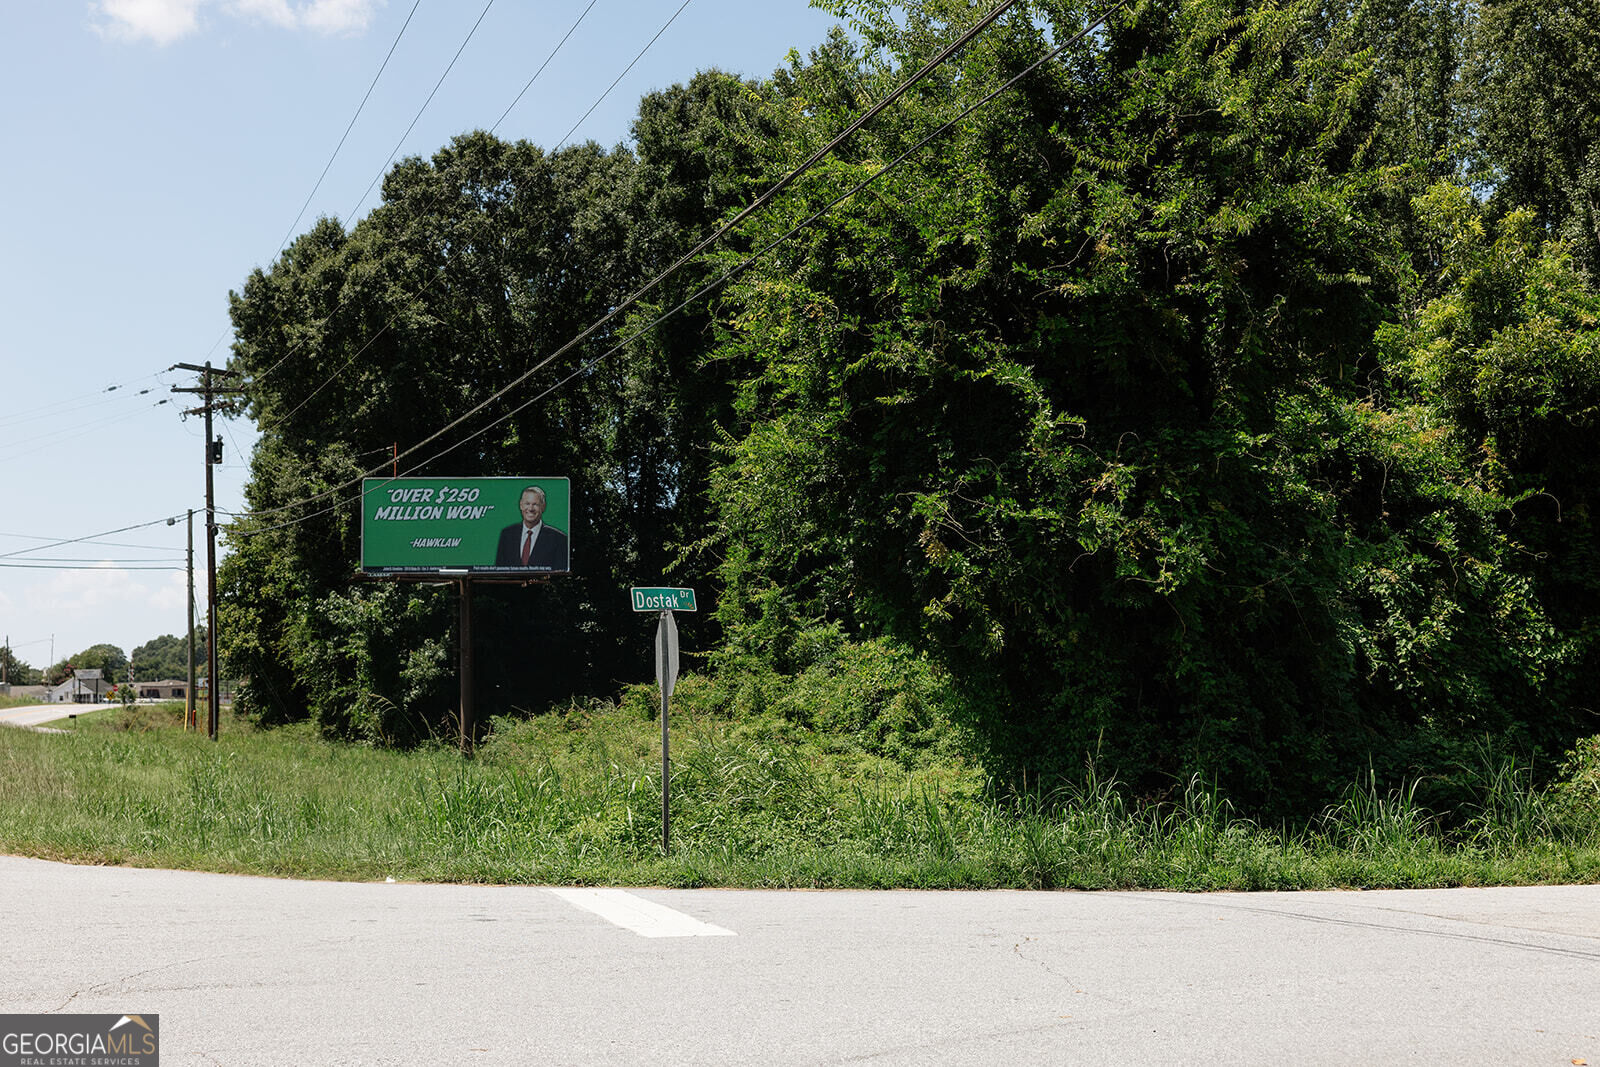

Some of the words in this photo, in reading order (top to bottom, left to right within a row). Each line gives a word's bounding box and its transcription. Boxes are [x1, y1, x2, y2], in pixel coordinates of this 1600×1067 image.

[387, 488, 434, 503] "OVER
[435, 486, 480, 504] $250
[374, 505, 444, 521] MILLION
[446, 505, 494, 520] WON!"
[410, 538, 462, 548] -HAWKLAW
[636, 591, 679, 608] Dostak
